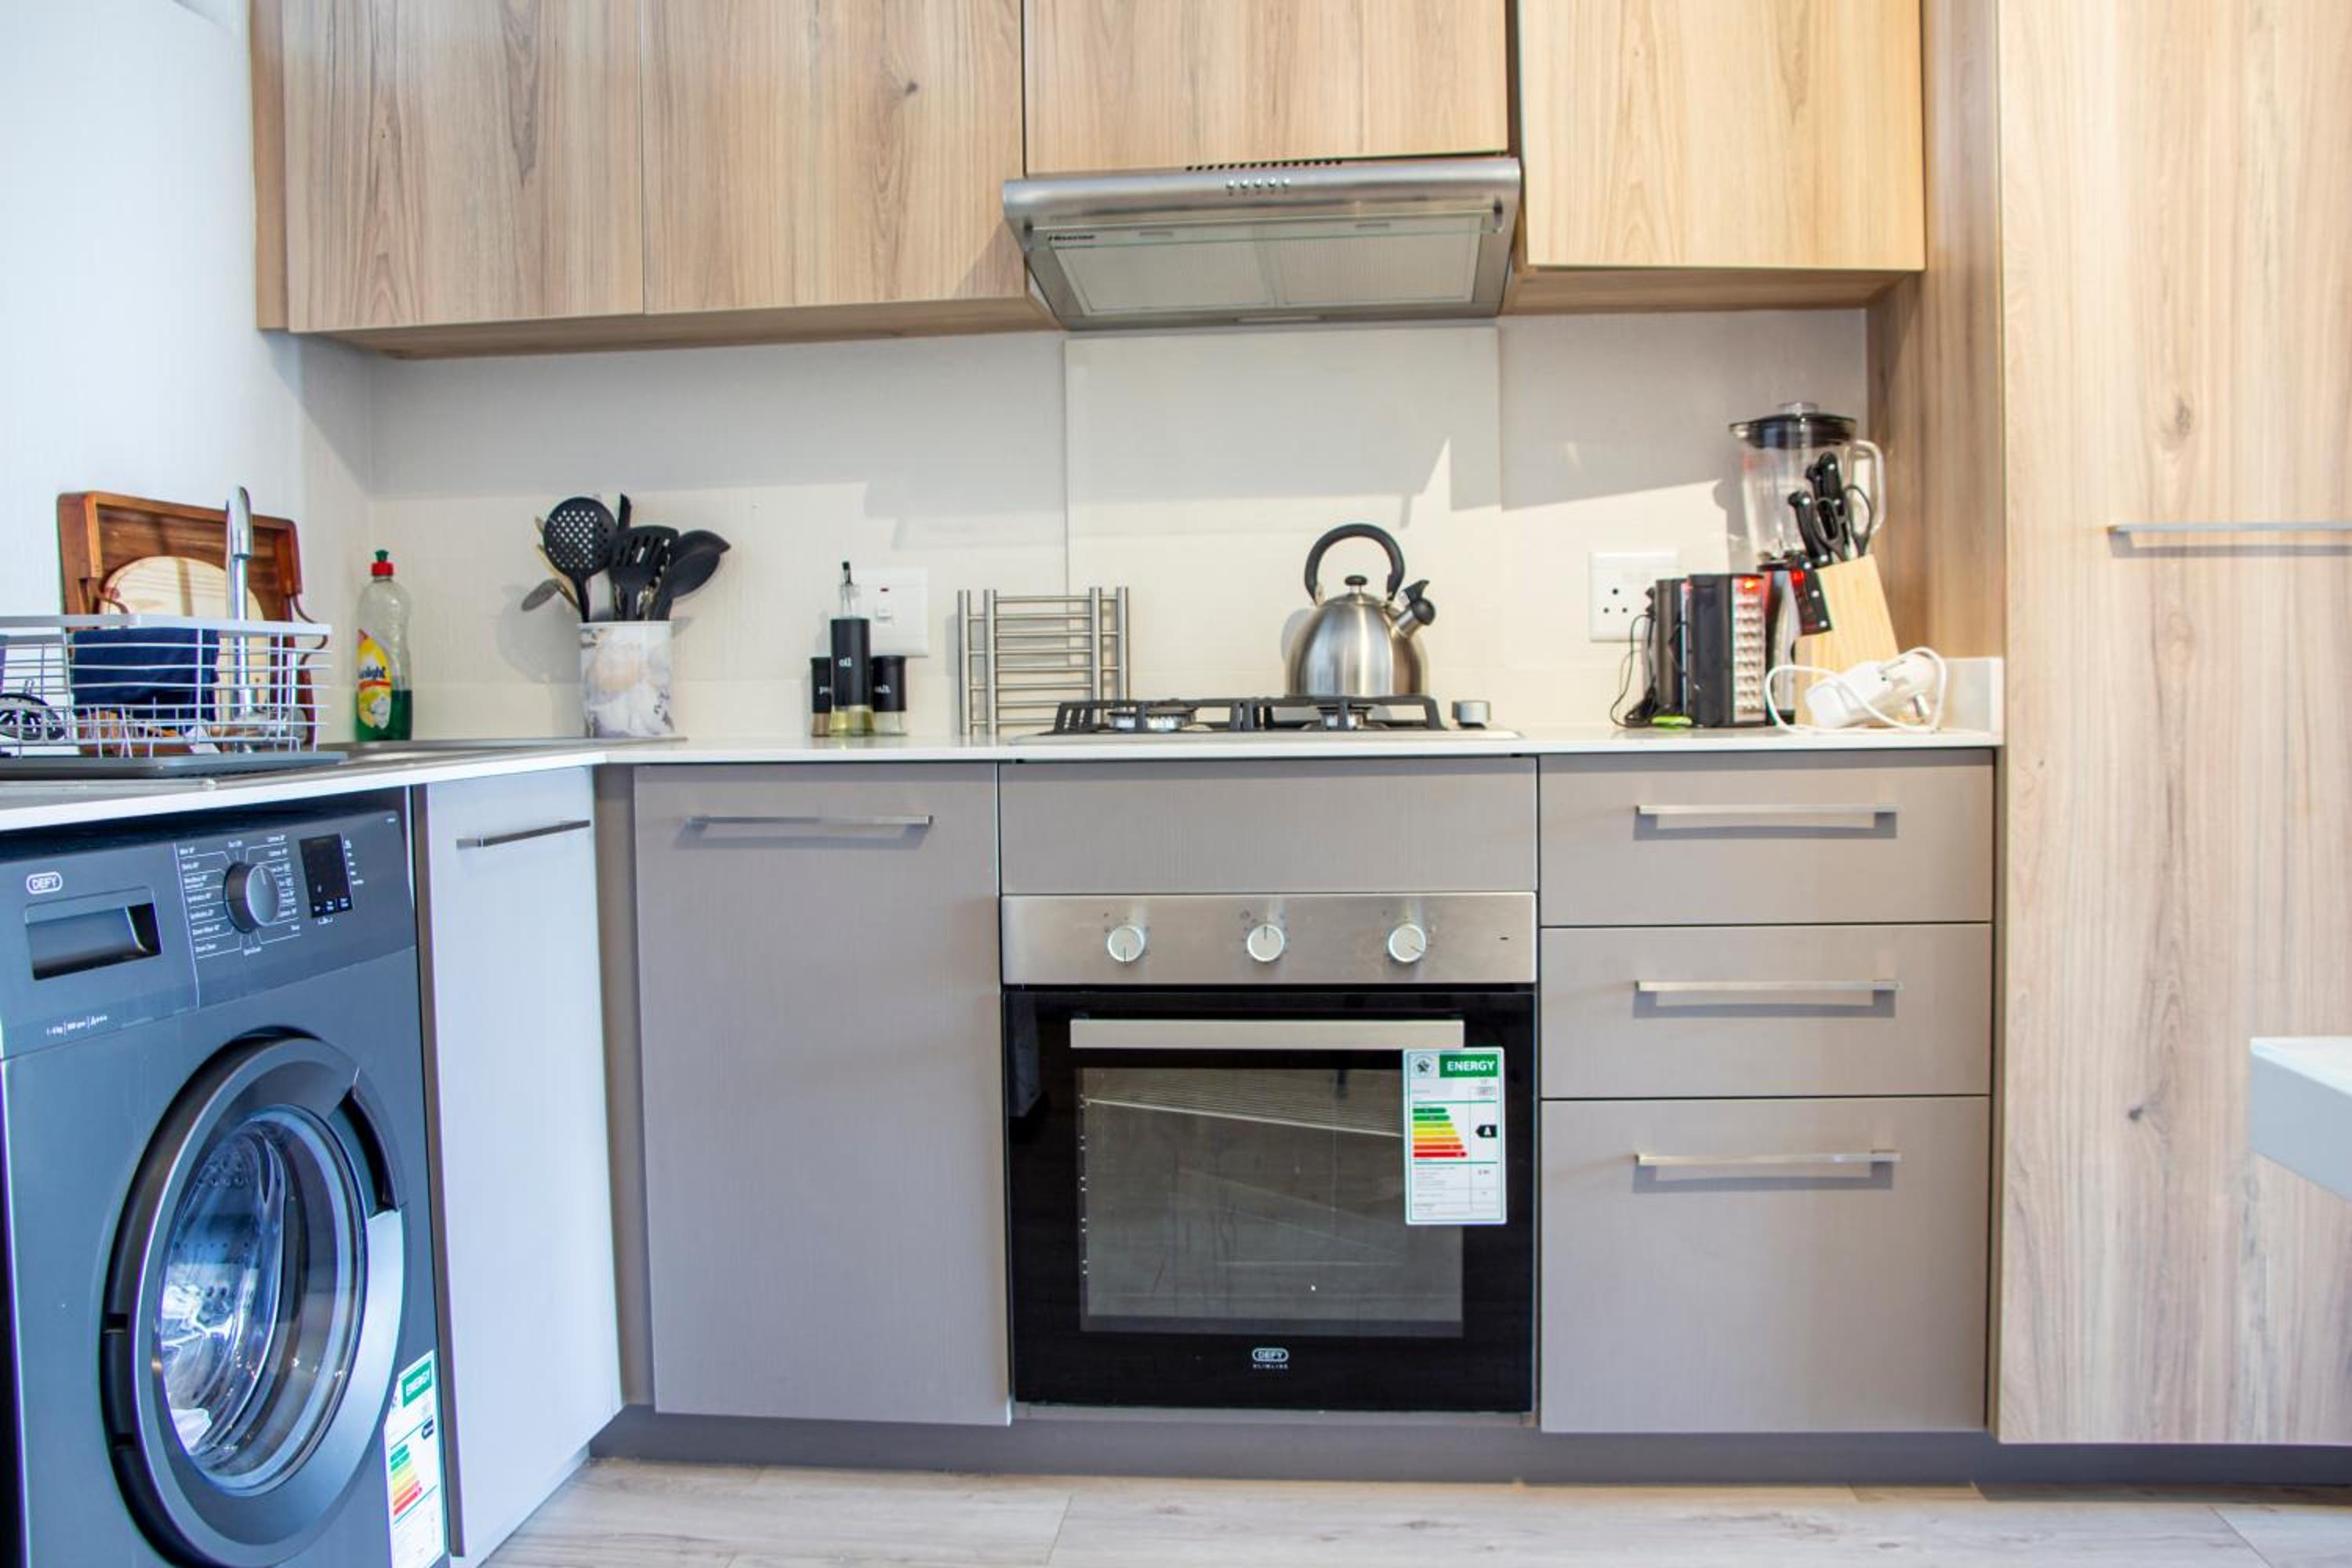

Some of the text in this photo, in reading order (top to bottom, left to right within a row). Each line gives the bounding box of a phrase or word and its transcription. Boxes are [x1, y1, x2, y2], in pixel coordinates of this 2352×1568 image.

[838, 657, 852, 667] oil
[31, 875, 58, 891] DEFY
[1447, 1060, 1495, 1072] ENERGY
[1257, 1350, 1285, 1360] DEFY
